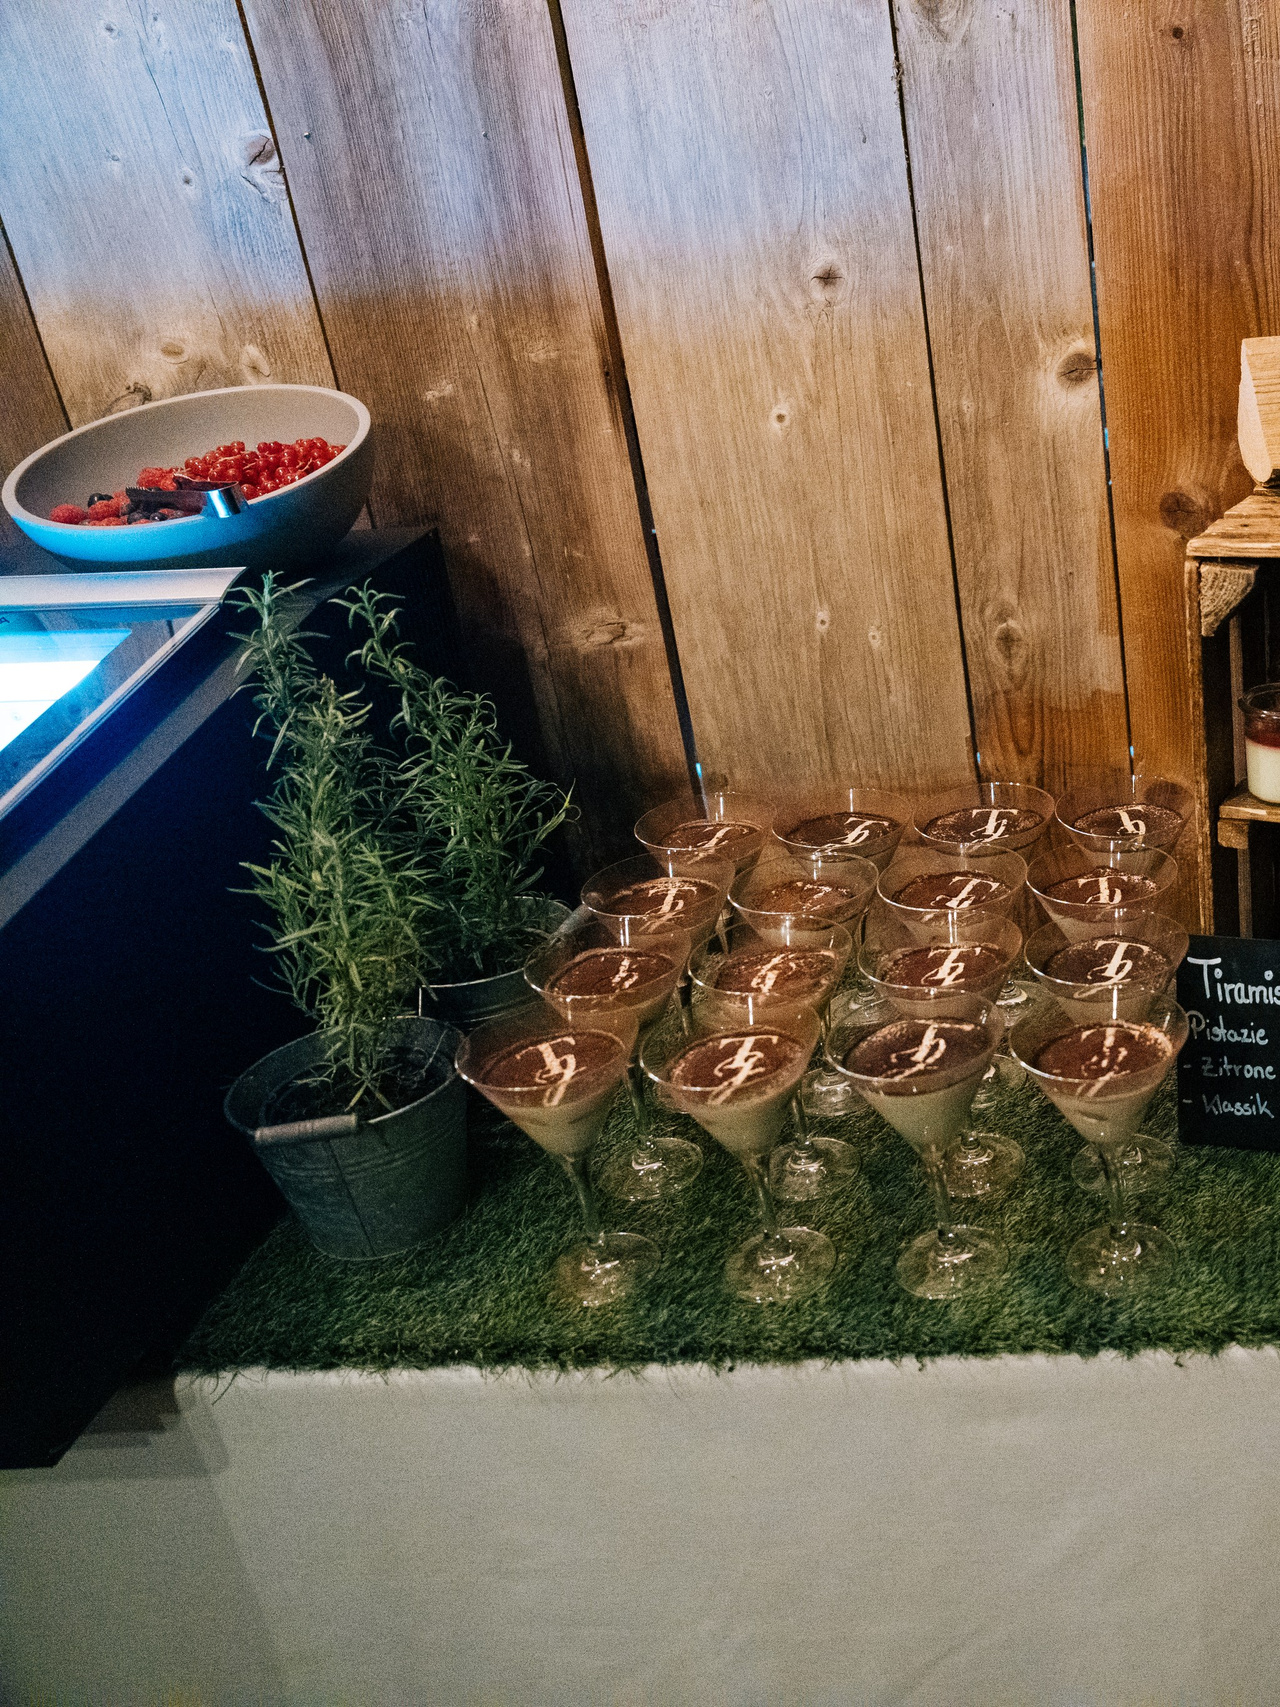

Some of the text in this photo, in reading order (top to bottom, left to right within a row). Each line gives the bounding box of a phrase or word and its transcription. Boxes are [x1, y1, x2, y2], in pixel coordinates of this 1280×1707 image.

[1186, 1010, 1269, 1045] Pistazie
[1201, 1055, 1276, 1080] Zitrone
[1202, 1092, 1275, 1119] Klassik
